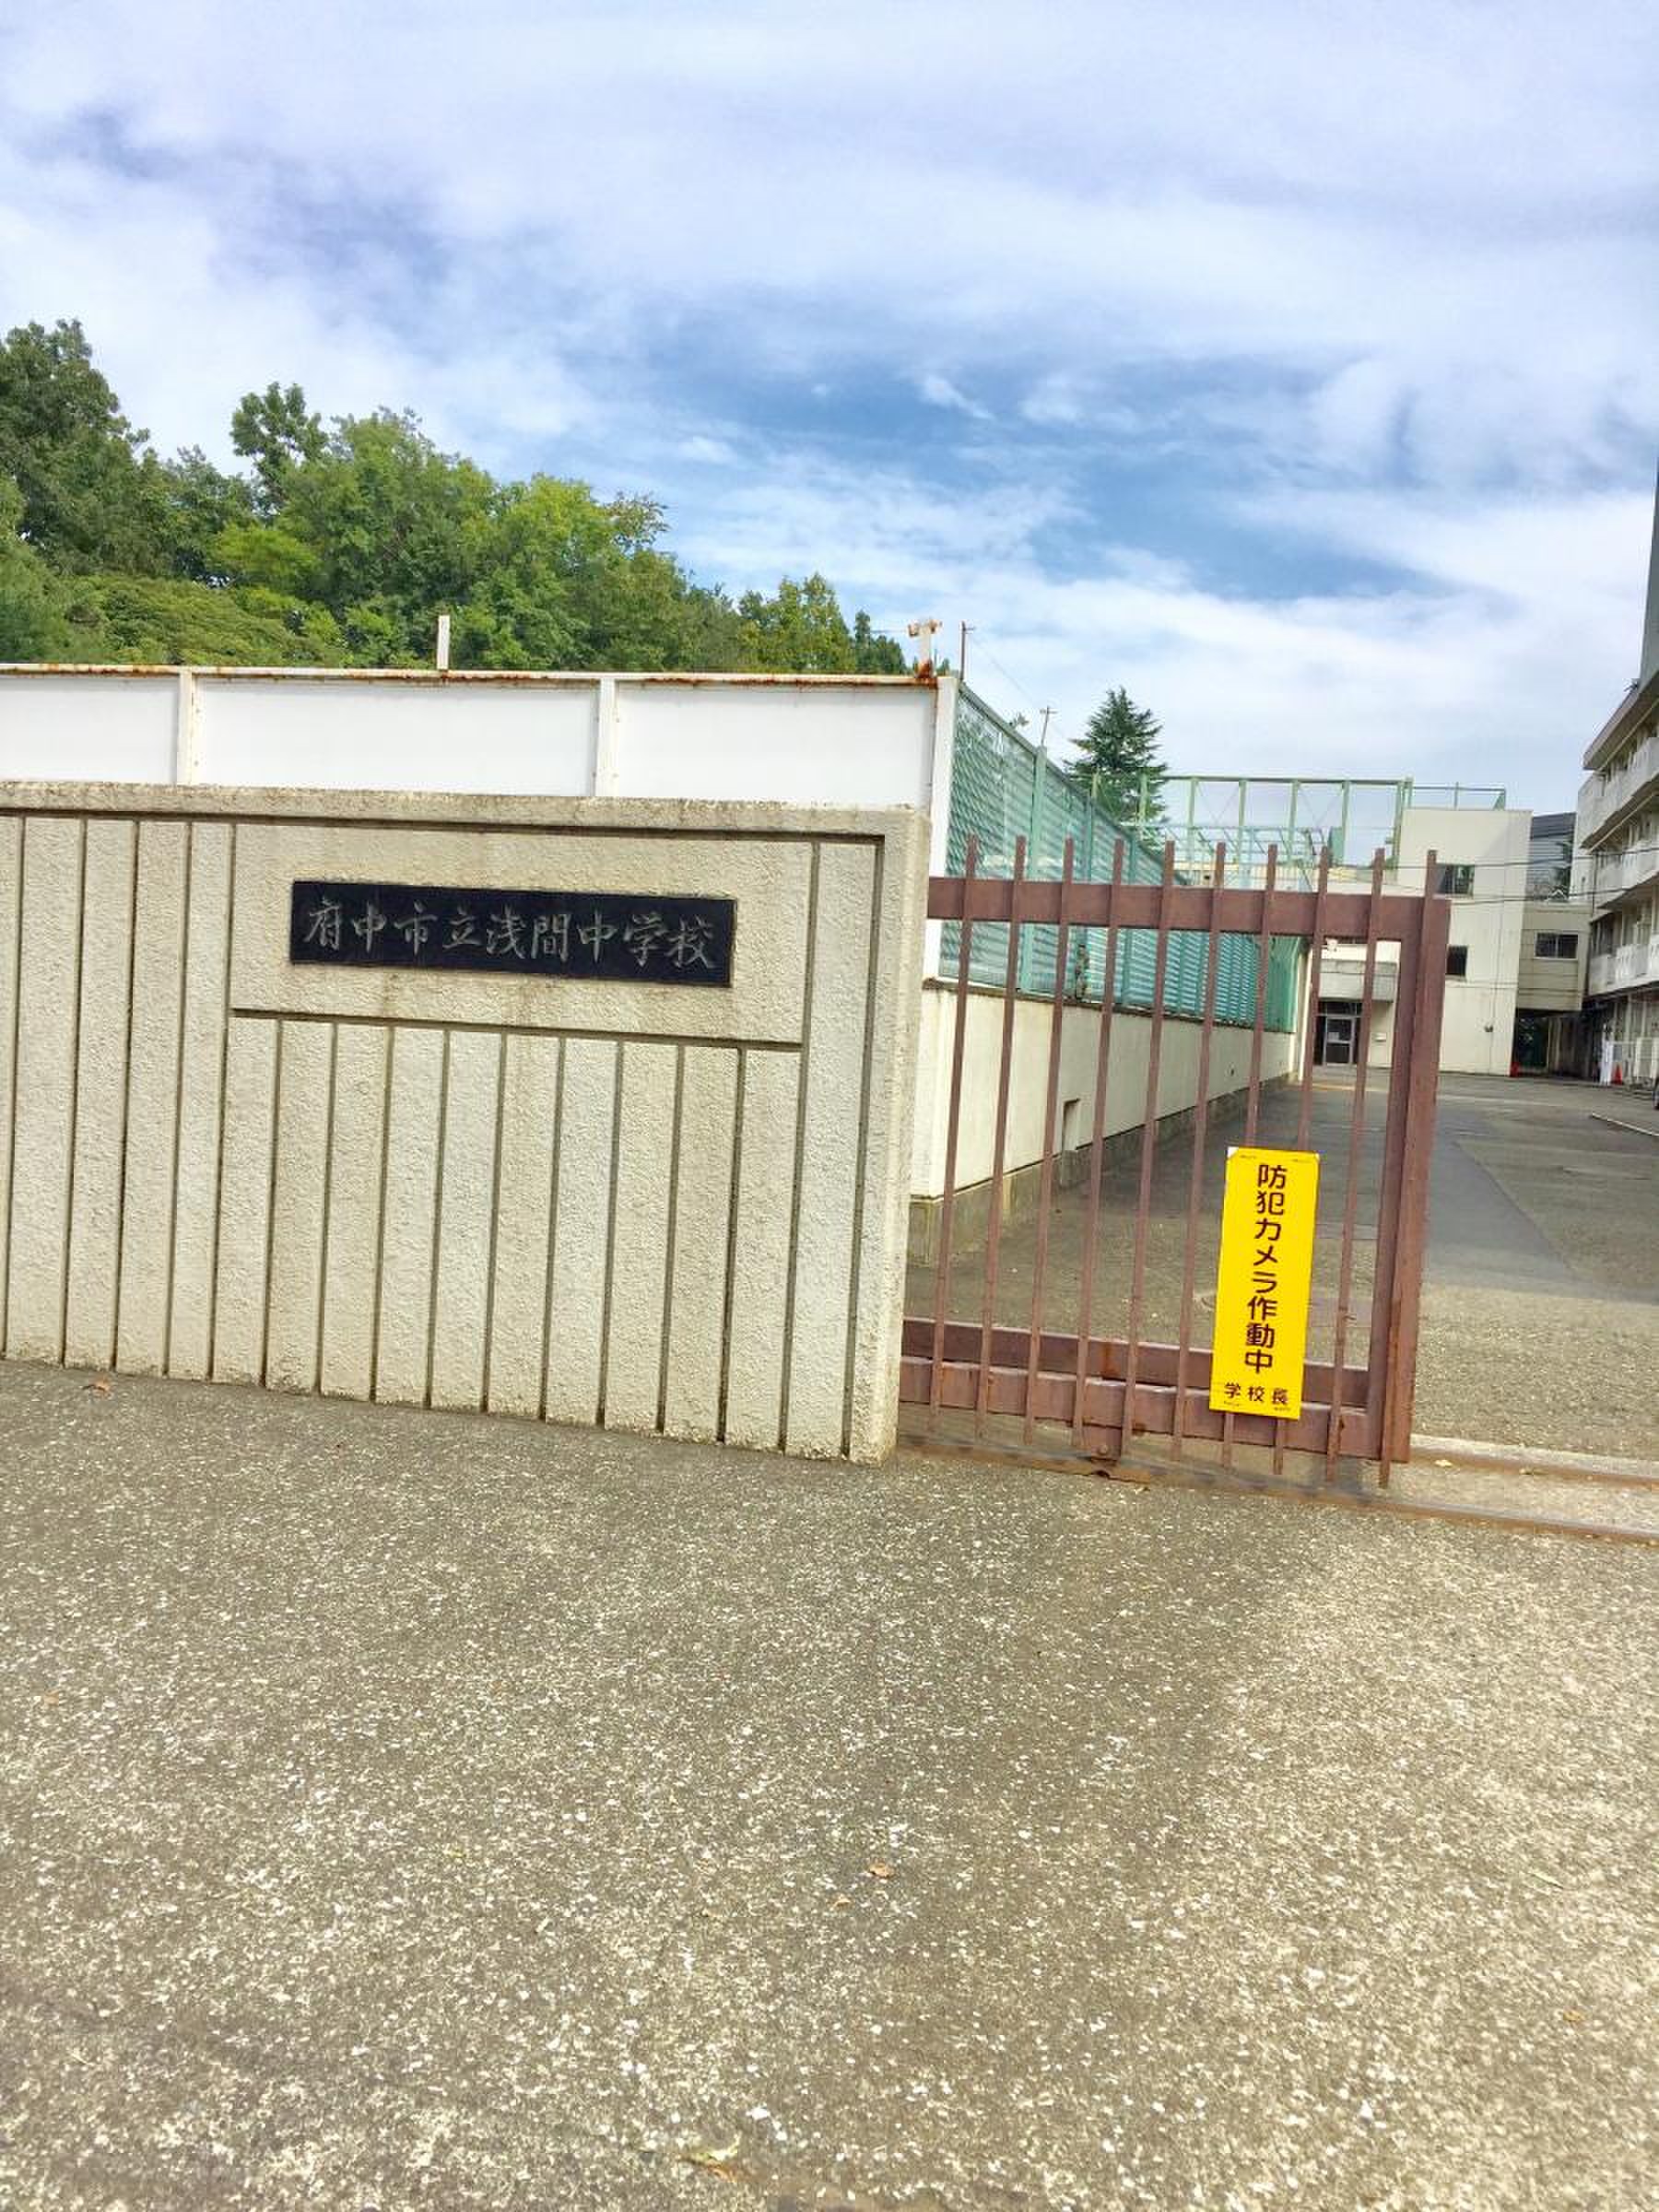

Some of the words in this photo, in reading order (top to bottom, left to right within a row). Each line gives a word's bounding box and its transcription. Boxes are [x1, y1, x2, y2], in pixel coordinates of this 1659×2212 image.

[303, 900, 718, 969] 府中市立浅間中学校
[1244, 1163, 1288, 1374] 防犯カメラ作動中
[1224, 1382, 1288, 1406] 学校長
